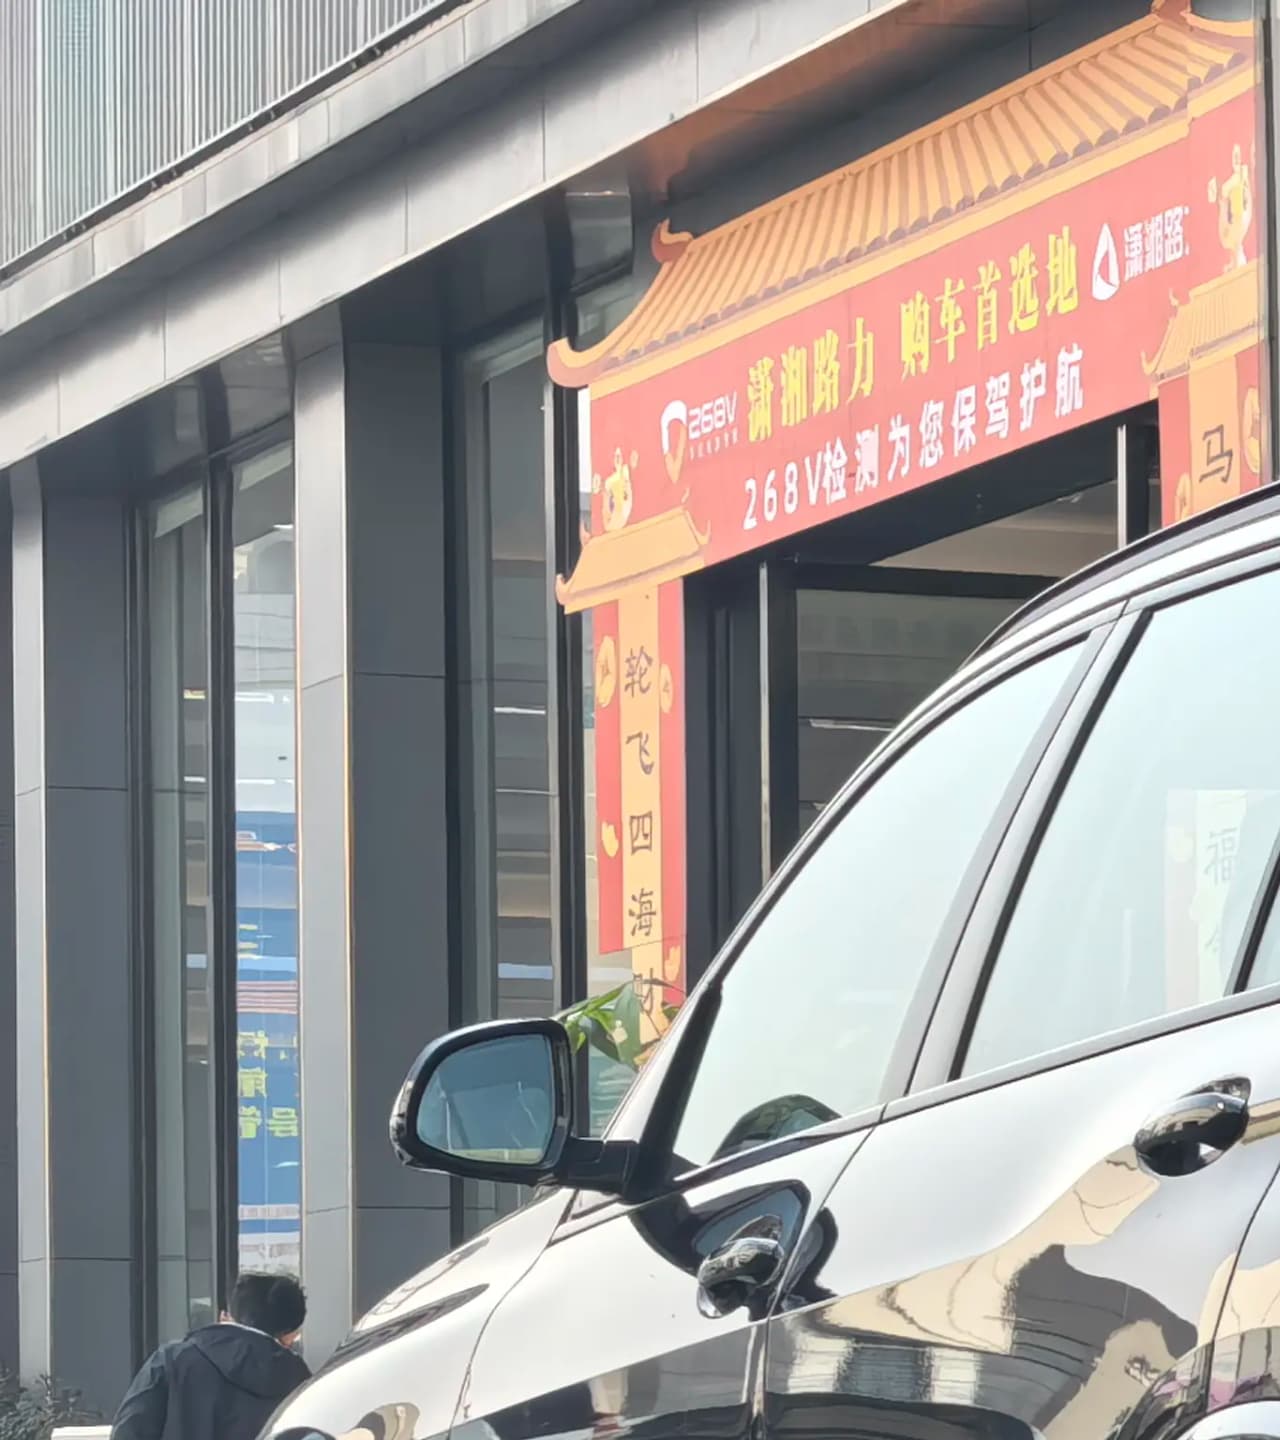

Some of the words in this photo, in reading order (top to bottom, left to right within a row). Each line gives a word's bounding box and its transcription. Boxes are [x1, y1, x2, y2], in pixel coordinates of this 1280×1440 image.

[900, 226, 1080, 383] 购车首选地
[688, 391, 737, 440] 268V
